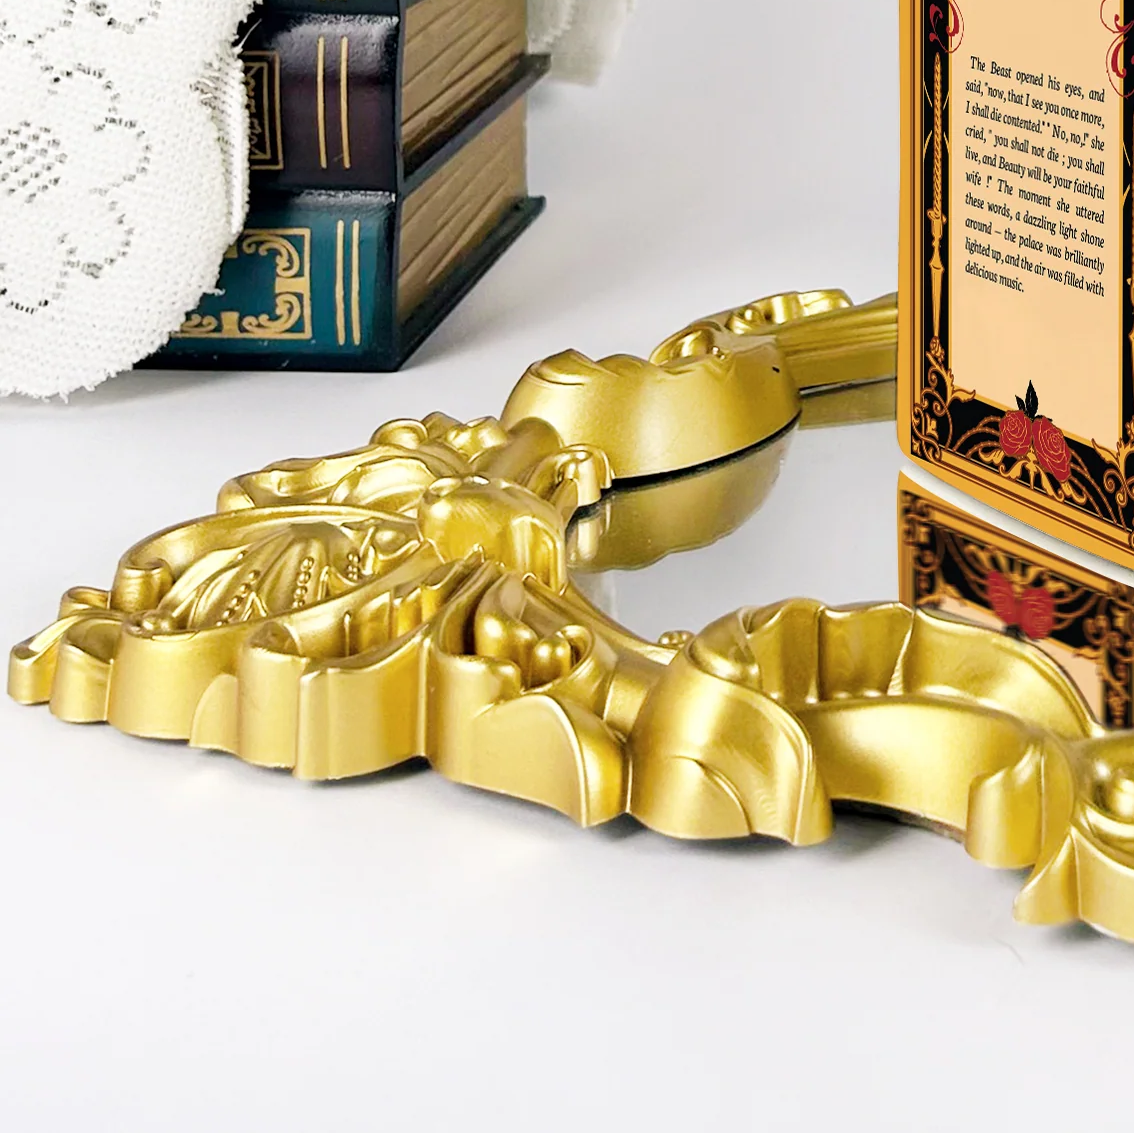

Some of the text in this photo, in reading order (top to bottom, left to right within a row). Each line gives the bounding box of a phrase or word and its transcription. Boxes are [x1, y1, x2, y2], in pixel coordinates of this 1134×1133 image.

[965, 79, 983, 97] said,
[1007, 88, 1024, 105] that
[1025, 93, 1030, 107] I
[1030, 98, 1043, 110] see
[1043, 101, 1059, 115] you
[1060, 106, 1079, 120] once
[1080, 111, 1105, 130] more,
[970, 55, 1105, 103] The Beast opened his eyes, and
[965, 100, 970, 113] I
[971, 102, 989, 119] shall
[989, 107, 1002, 122] die
[1090, 135, 1105, 152] she
[965, 124, 986, 144] cried,
[993, 134, 1008, 148] you
[1010, 136, 1029, 154] shall
[1031, 145, 1045, 158] not
[1046, 146, 1059, 162] die
[1066, 155, 1083, 170] you
[1084, 157, 1105, 176] shall
[965, 145, 1105, 200] live, and Beauty will be your faithful
[965, 170, 981, 186] wife
[997, 178, 1013, 196] The
[1018, 188, 1051, 208] moment
[1056, 197, 1070, 213] she
[1075, 205, 1105, 224] uttered
[965, 191, 1104, 248] these words, a dazzling light shone
[965, 217, 992, 235] around
[1003, 227, 1016, 243] the
[1018, 234, 1044, 252] palace
[1045, 244, 1062, 258] was
[1064, 246, 1104, 275] brilliantly
[964, 259, 1024, 293] delicious music.
[965, 236, 1104, 297] lighted up, and the air was filled with
